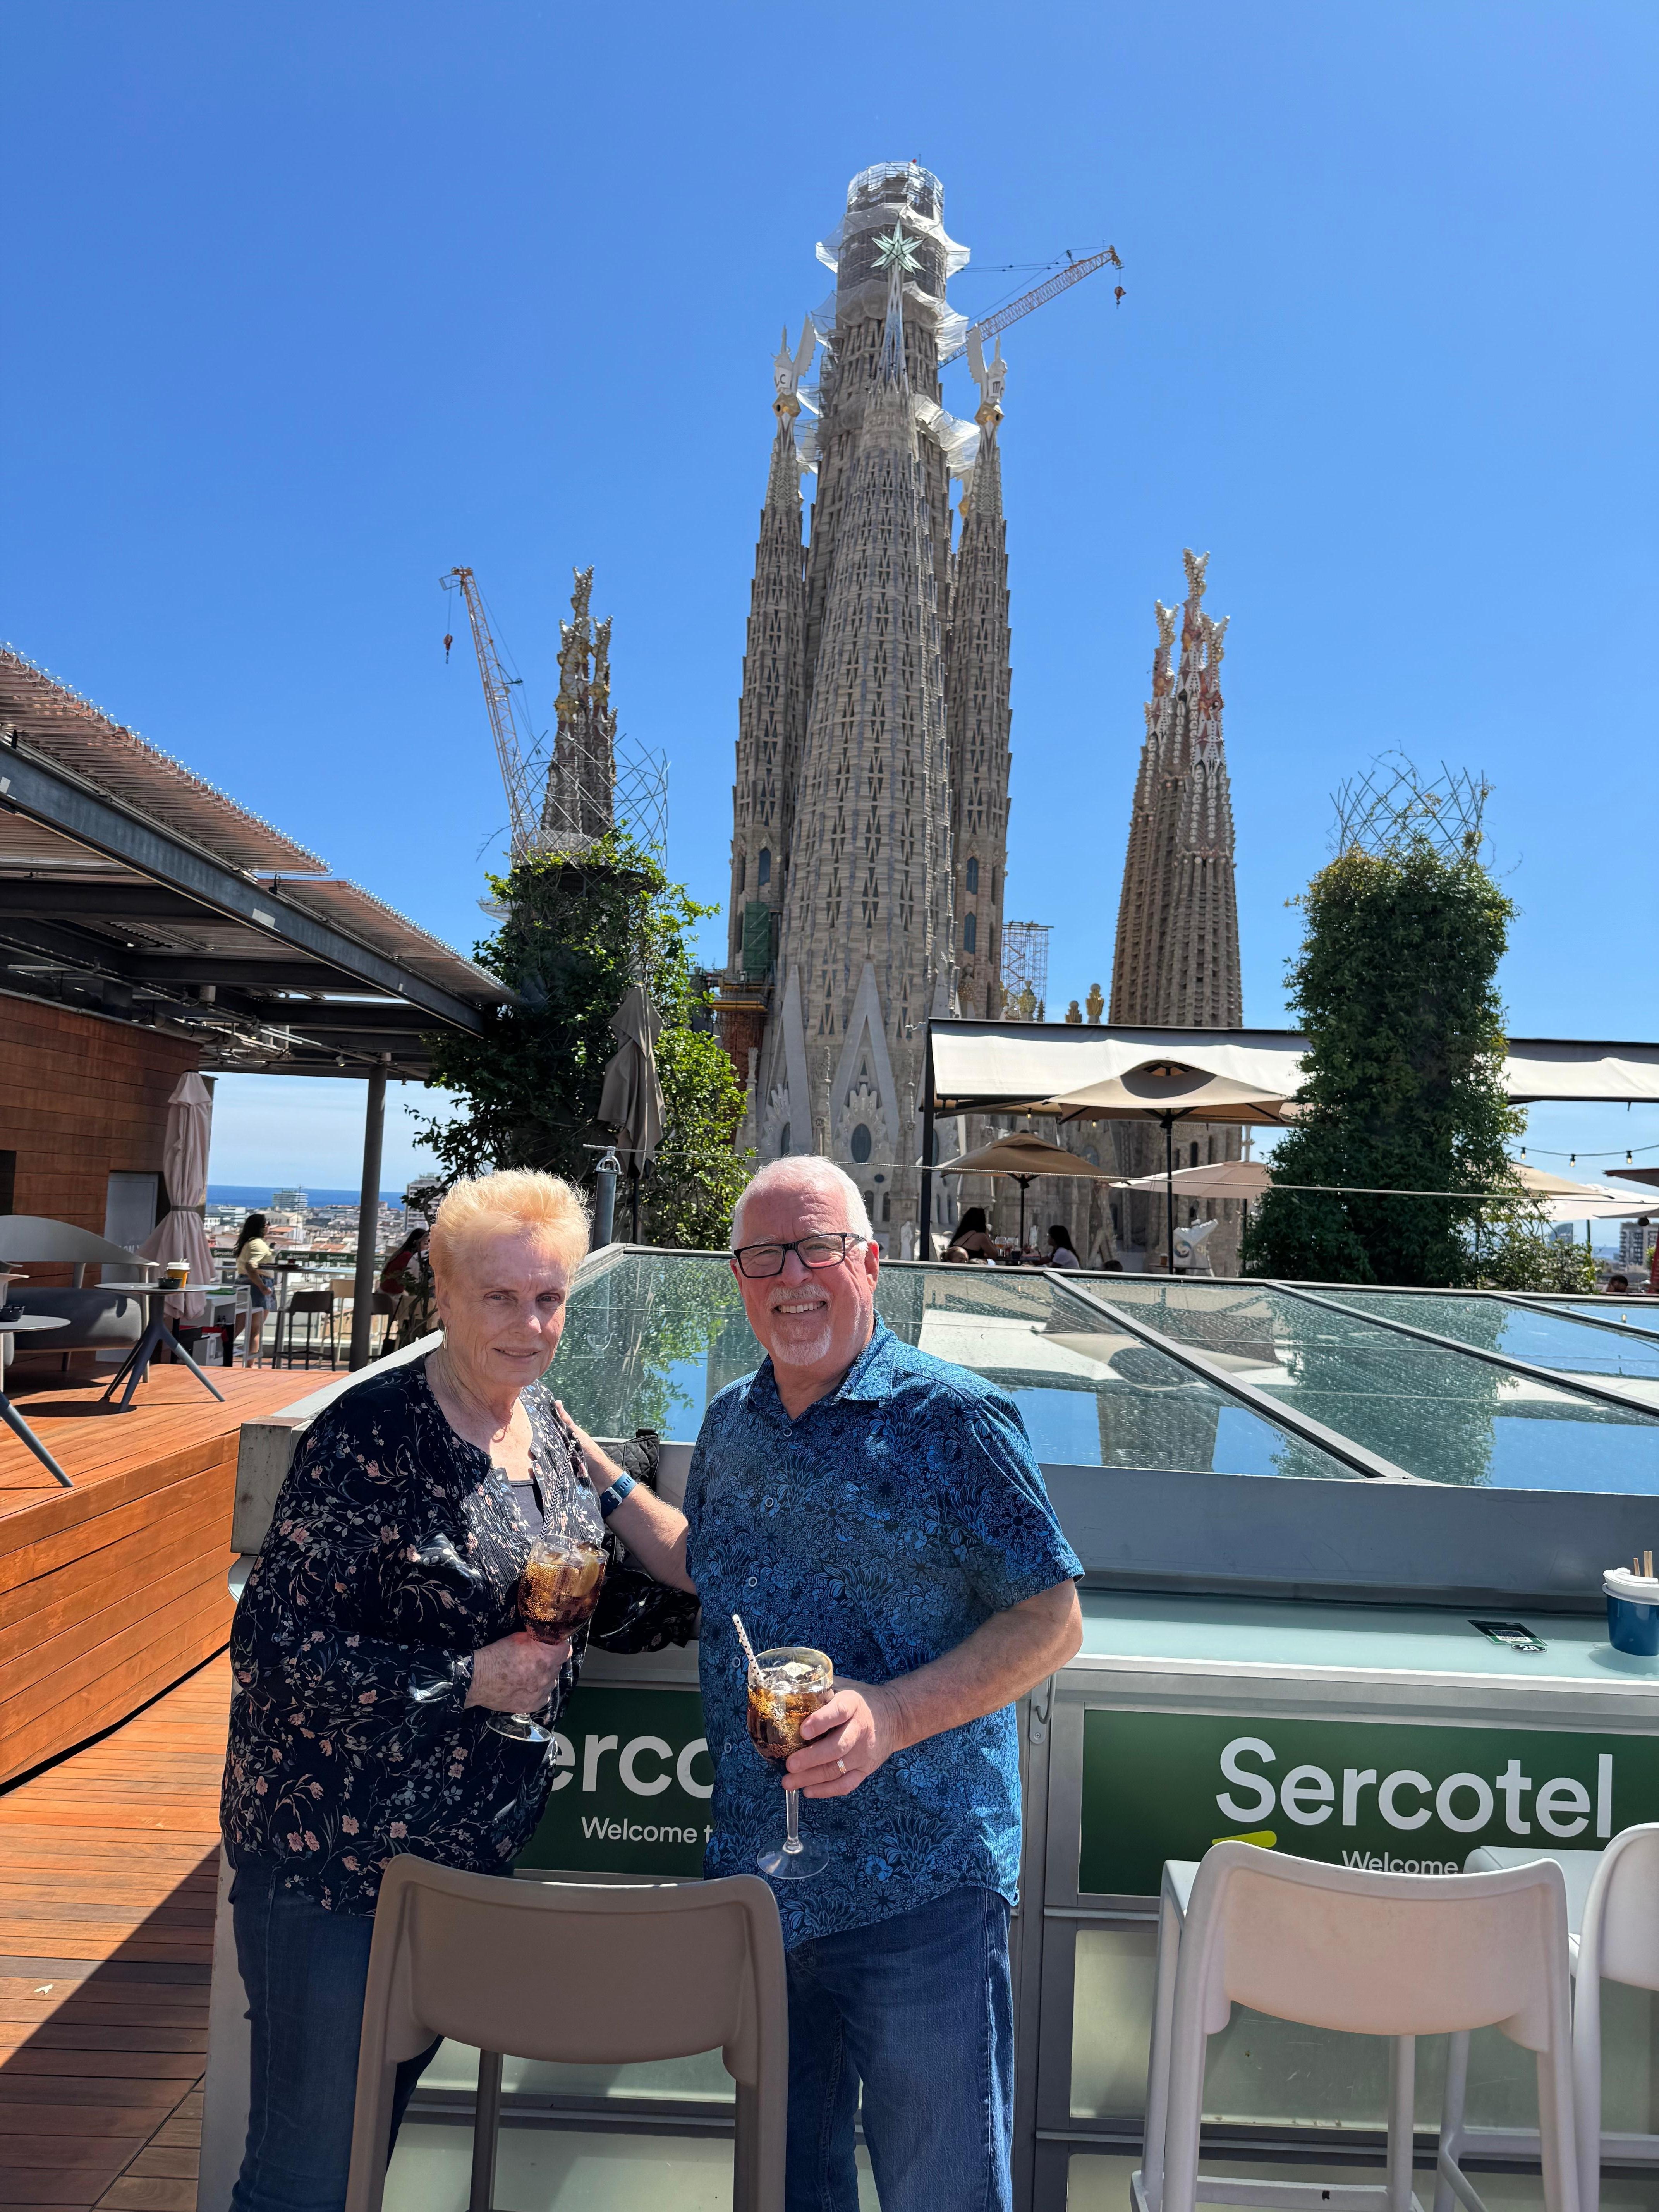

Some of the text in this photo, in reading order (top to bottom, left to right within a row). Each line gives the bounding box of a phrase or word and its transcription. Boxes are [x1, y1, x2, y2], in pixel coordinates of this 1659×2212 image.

[1216, 1737, 1613, 1838] Sercotel
[581, 1816, 697, 1843] Welcome
[1341, 1850, 1458, 1874] Welcome
